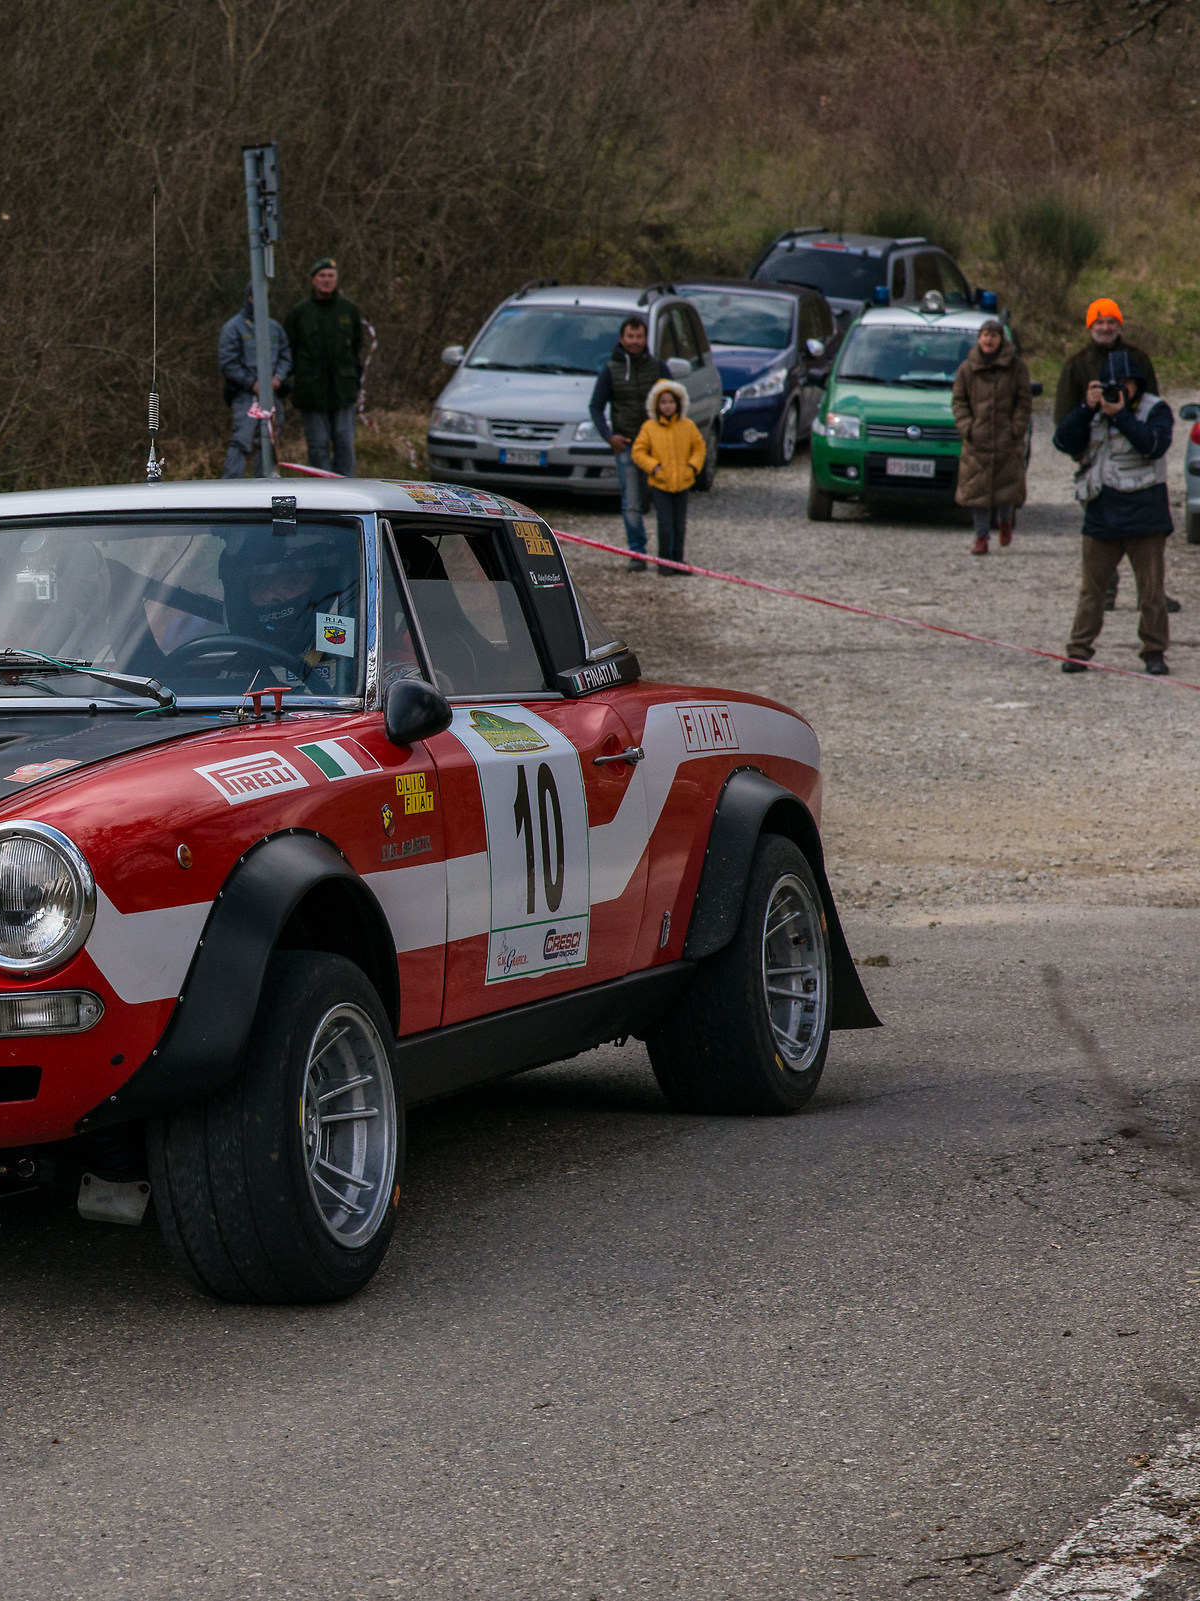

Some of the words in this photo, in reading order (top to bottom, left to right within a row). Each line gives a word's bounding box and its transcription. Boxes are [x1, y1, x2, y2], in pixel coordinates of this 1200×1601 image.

[514, 523, 541, 537] OLIO
[526, 540, 552, 554] FIAT
[325, 616, 345, 625] R.I.A.
[583, 664, 612, 688] FINATI
[609, 662, 622, 681] M.
[683, 713, 733, 744] FIAT
[208, 757, 295, 796] PIRELLI
[396, 774, 425, 793] OLIO
[406, 793, 433, 812] FIAT
[514, 762, 565, 914] 10
[380, 843, 399, 862] FIAT
[545, 931, 582, 953] CRESCI
